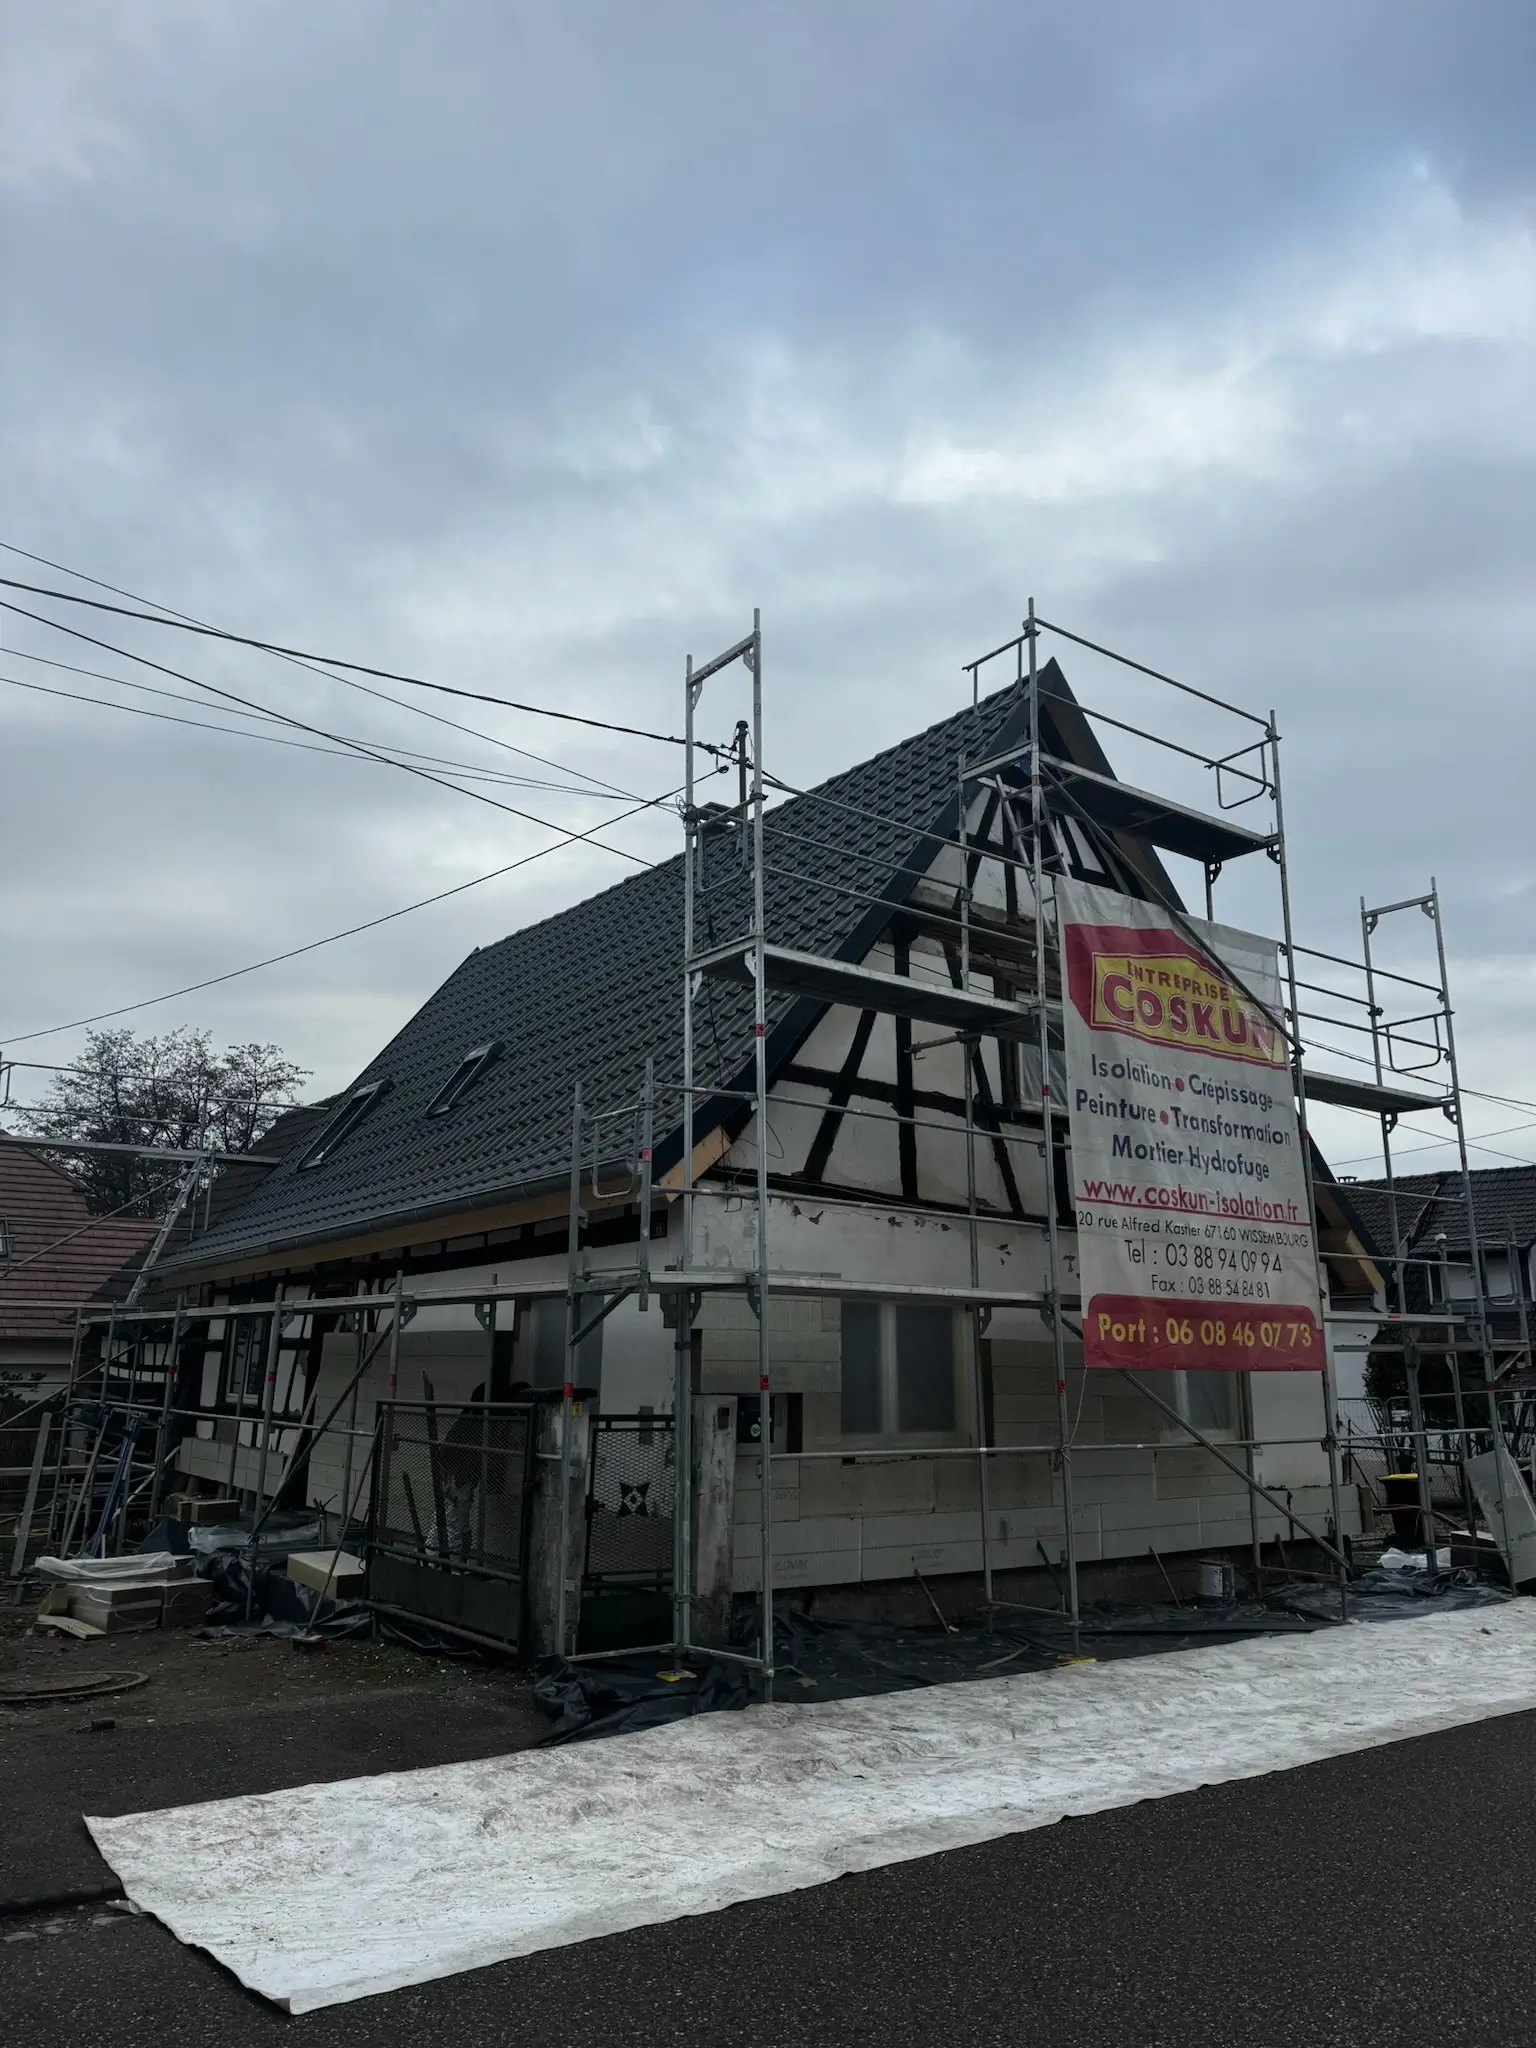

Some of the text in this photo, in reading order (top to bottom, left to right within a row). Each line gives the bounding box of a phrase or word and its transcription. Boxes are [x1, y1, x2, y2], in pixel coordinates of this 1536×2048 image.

[1127, 961, 1230, 1001] ENTREPRISE
[1101, 971, 1276, 1052] COSKUN
[1091, 1054, 1273, 1112] Isolation Crépissage
[1075, 1088, 1291, 1146] Peinture Transformation
[1112, 1134, 1270, 1182] Mortier Hydrofuge
[1078, 1210, 1309, 1248] 20 rue Alfred Kastler 67160 WISSEMBOURG
[1124, 1239, 1146, 1264] Tel
[1165, 1242, 1188, 1267] 03
[1194, 1245, 1214, 1269] 88
[1218, 1248, 1237, 1271] 94
[1241, 1250, 1257, 1273] 09
[1261, 1252, 1283, 1274] 94
[1151, 1274, 1177, 1293] Fax
[1188, 1276, 1204, 1294] 03
[1208, 1278, 1222, 1295] 88
[1226, 1279, 1240, 1296] 54
[1242, 1280, 1255, 1297] 84
[1256, 1281, 1270, 1298] 81
[1098, 1312, 1146, 1343] Port
[1165, 1317, 1195, 1345] 06
[1200, 1319, 1227, 1347] 08
[1232, 1321, 1256, 1347] 46
[1260, 1322, 1283, 1348] 07
[1286, 1323, 1312, 1348] 73
